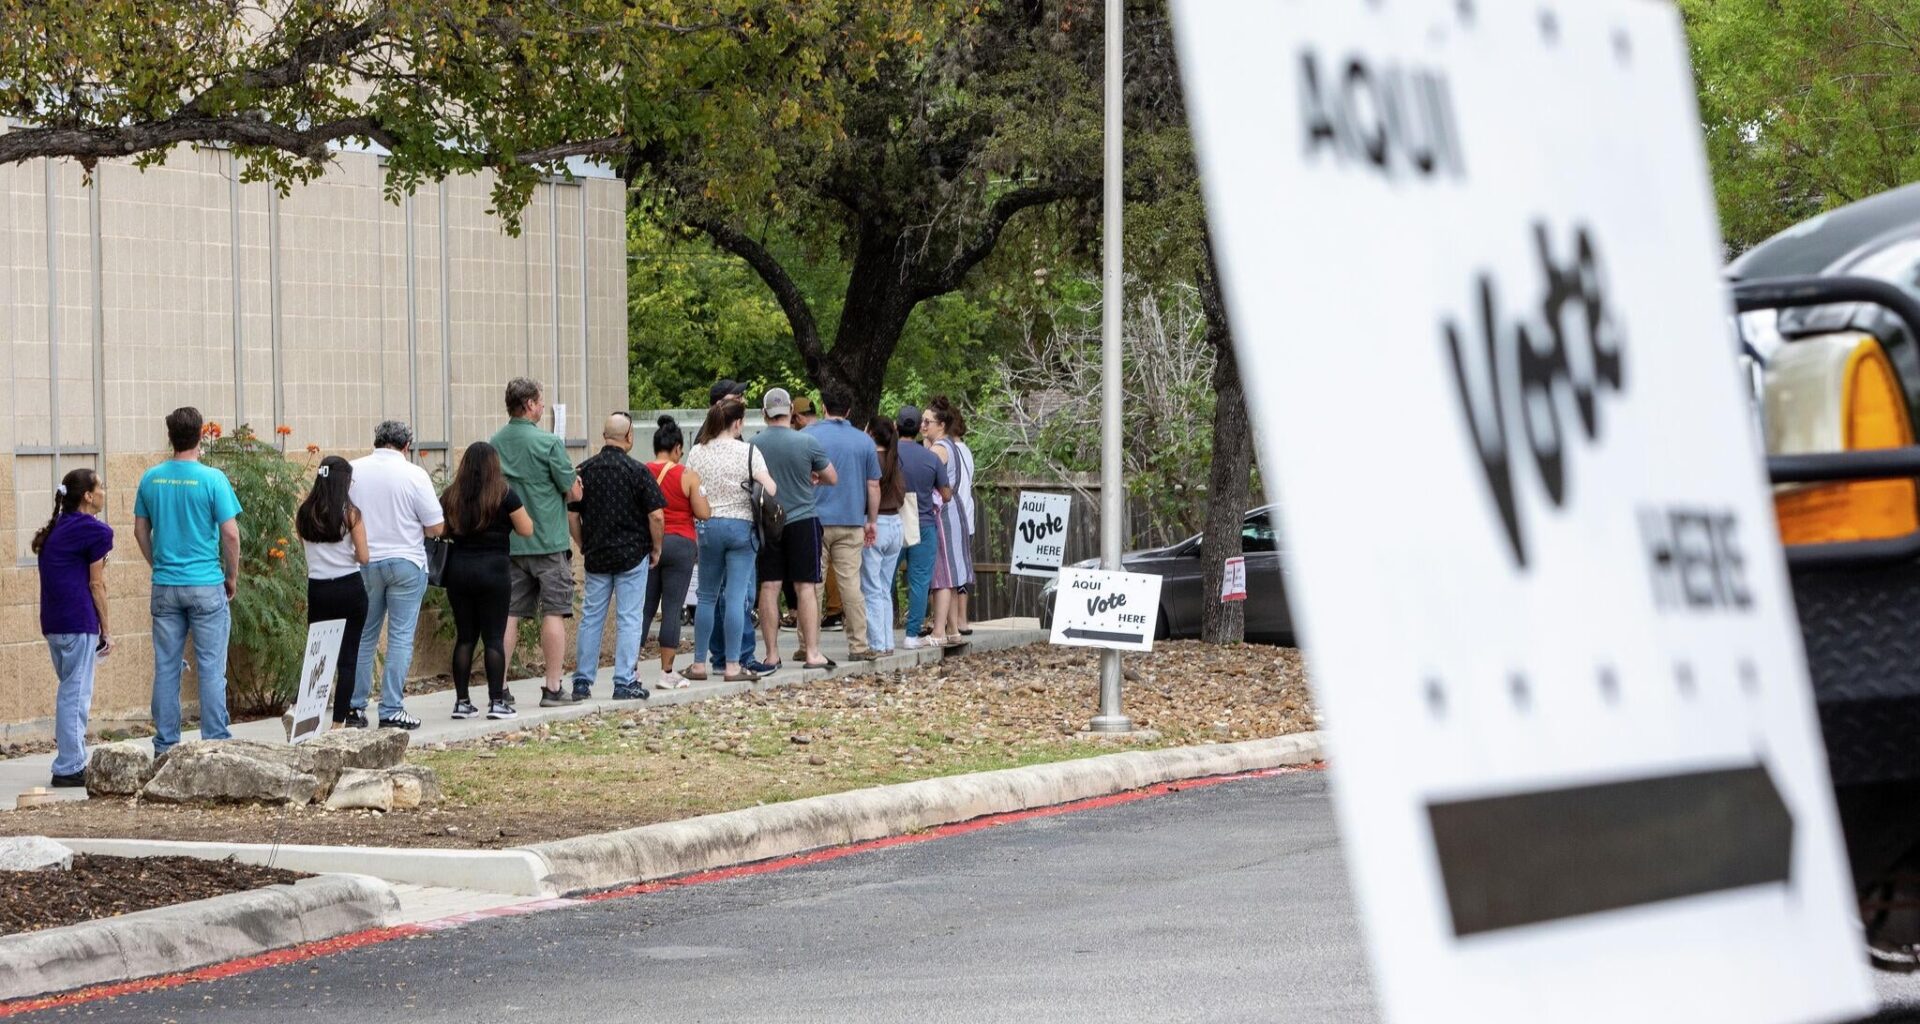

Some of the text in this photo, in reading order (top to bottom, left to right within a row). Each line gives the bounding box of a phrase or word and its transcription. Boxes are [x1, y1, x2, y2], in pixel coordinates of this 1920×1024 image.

[1442, 218, 1627, 573] Vote
[1019, 513, 1063, 544] Vote
[1036, 545, 1061, 556] HERE
[1636, 502, 1757, 613] HERE
[1087, 593, 1127, 616] Vote
[1118, 613, 1146, 624] HERE
[307, 654, 327, 698] Vote
[316, 684, 329, 699] HERE
